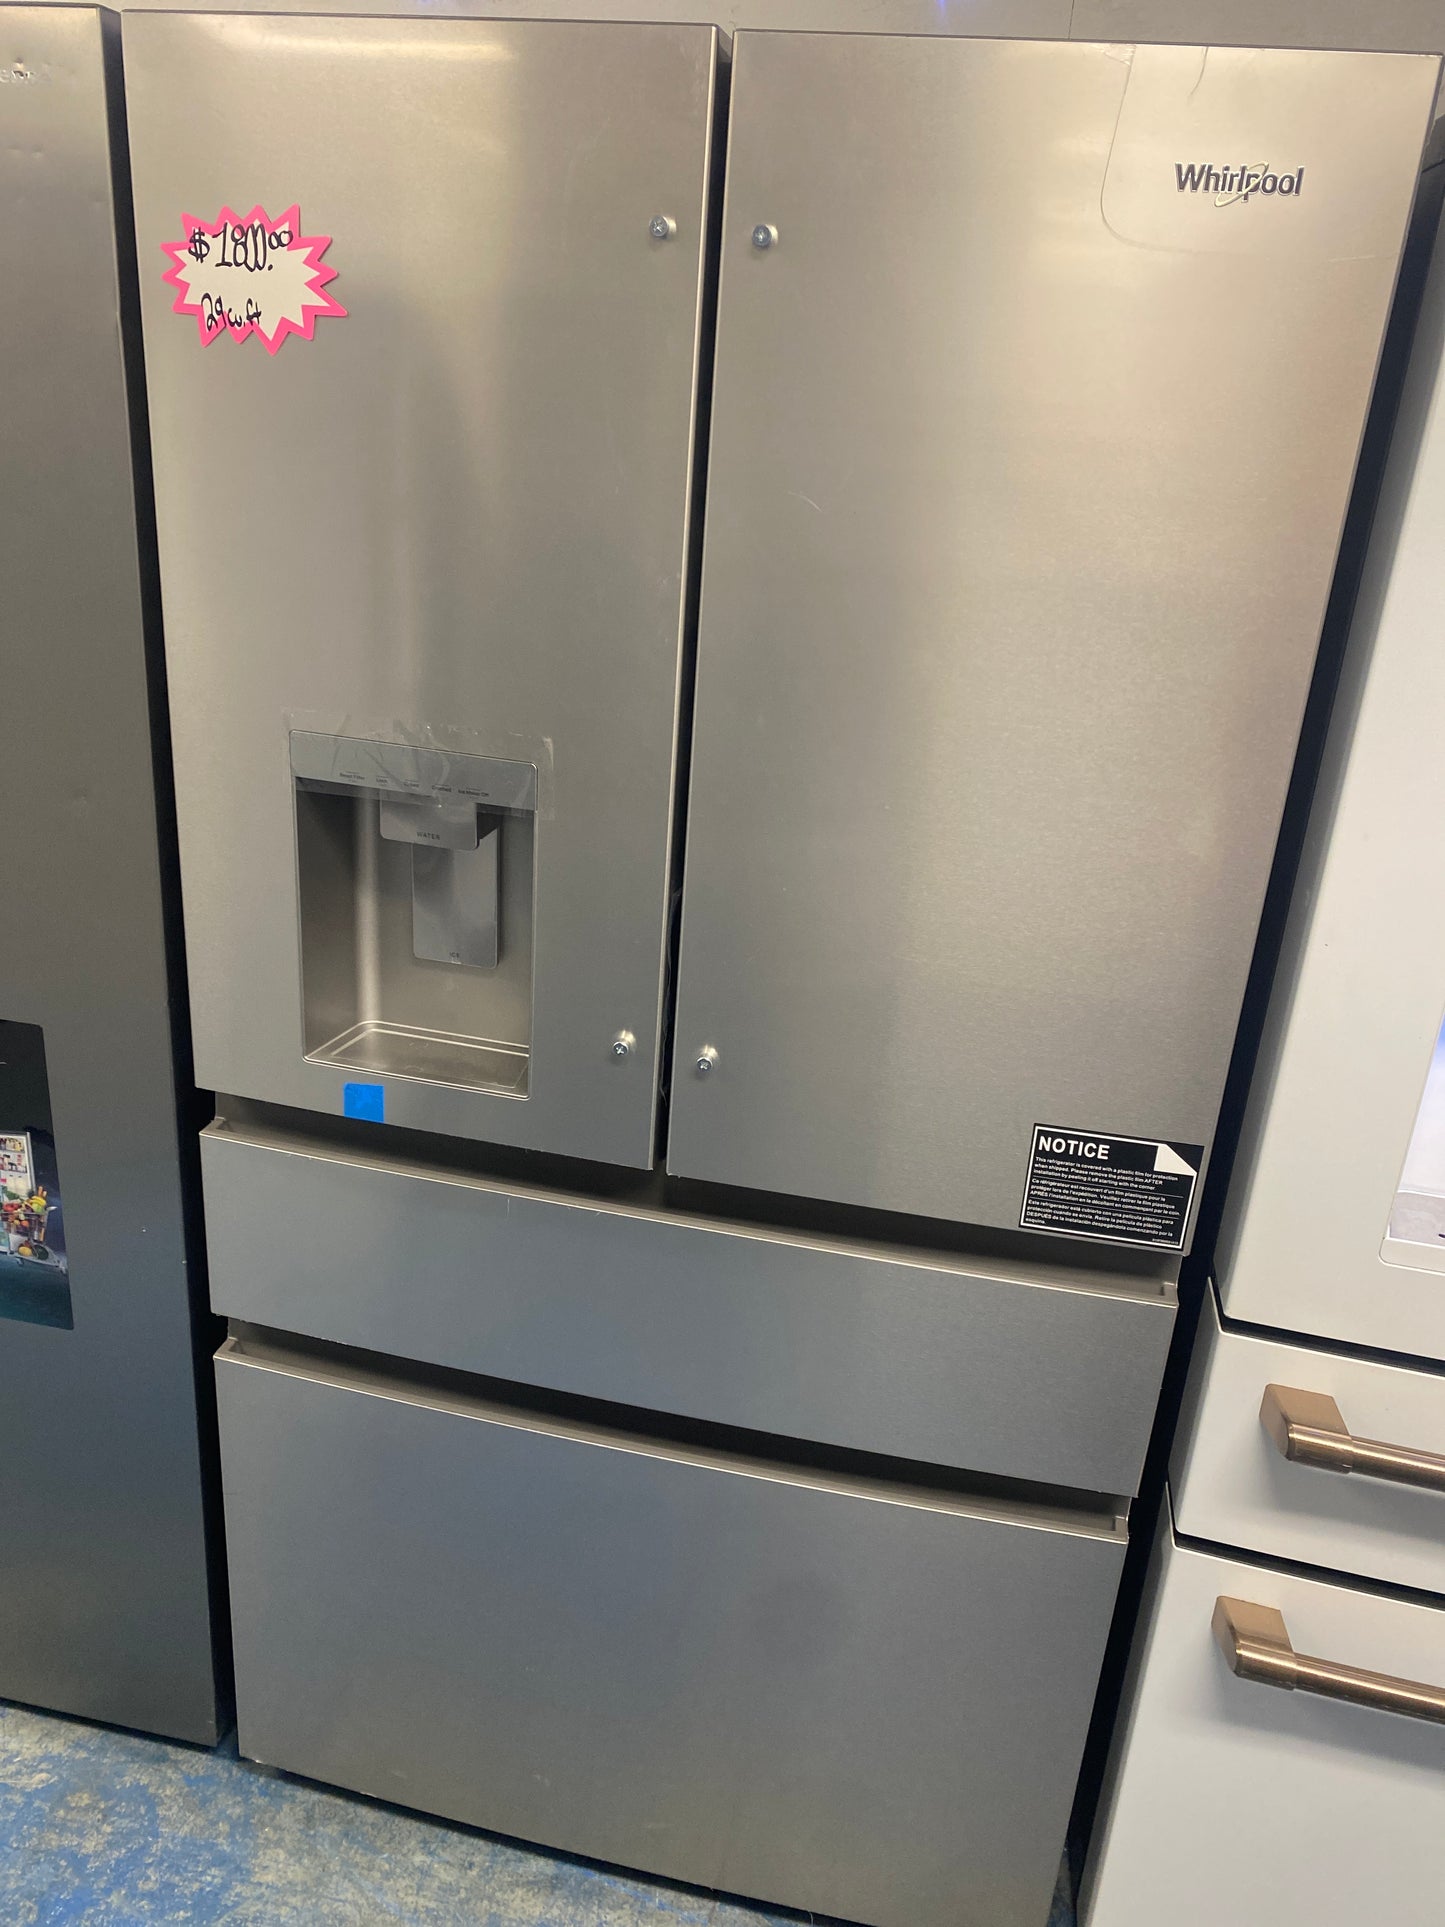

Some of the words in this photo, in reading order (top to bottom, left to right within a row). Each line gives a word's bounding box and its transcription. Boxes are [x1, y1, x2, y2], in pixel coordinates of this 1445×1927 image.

[1175, 162, 1304, 202] Whirlpool
[416, 831, 440, 841] WATER
[449, 951, 460, 959] ICE
[1038, 1136, 1110, 1160] NOTICE
